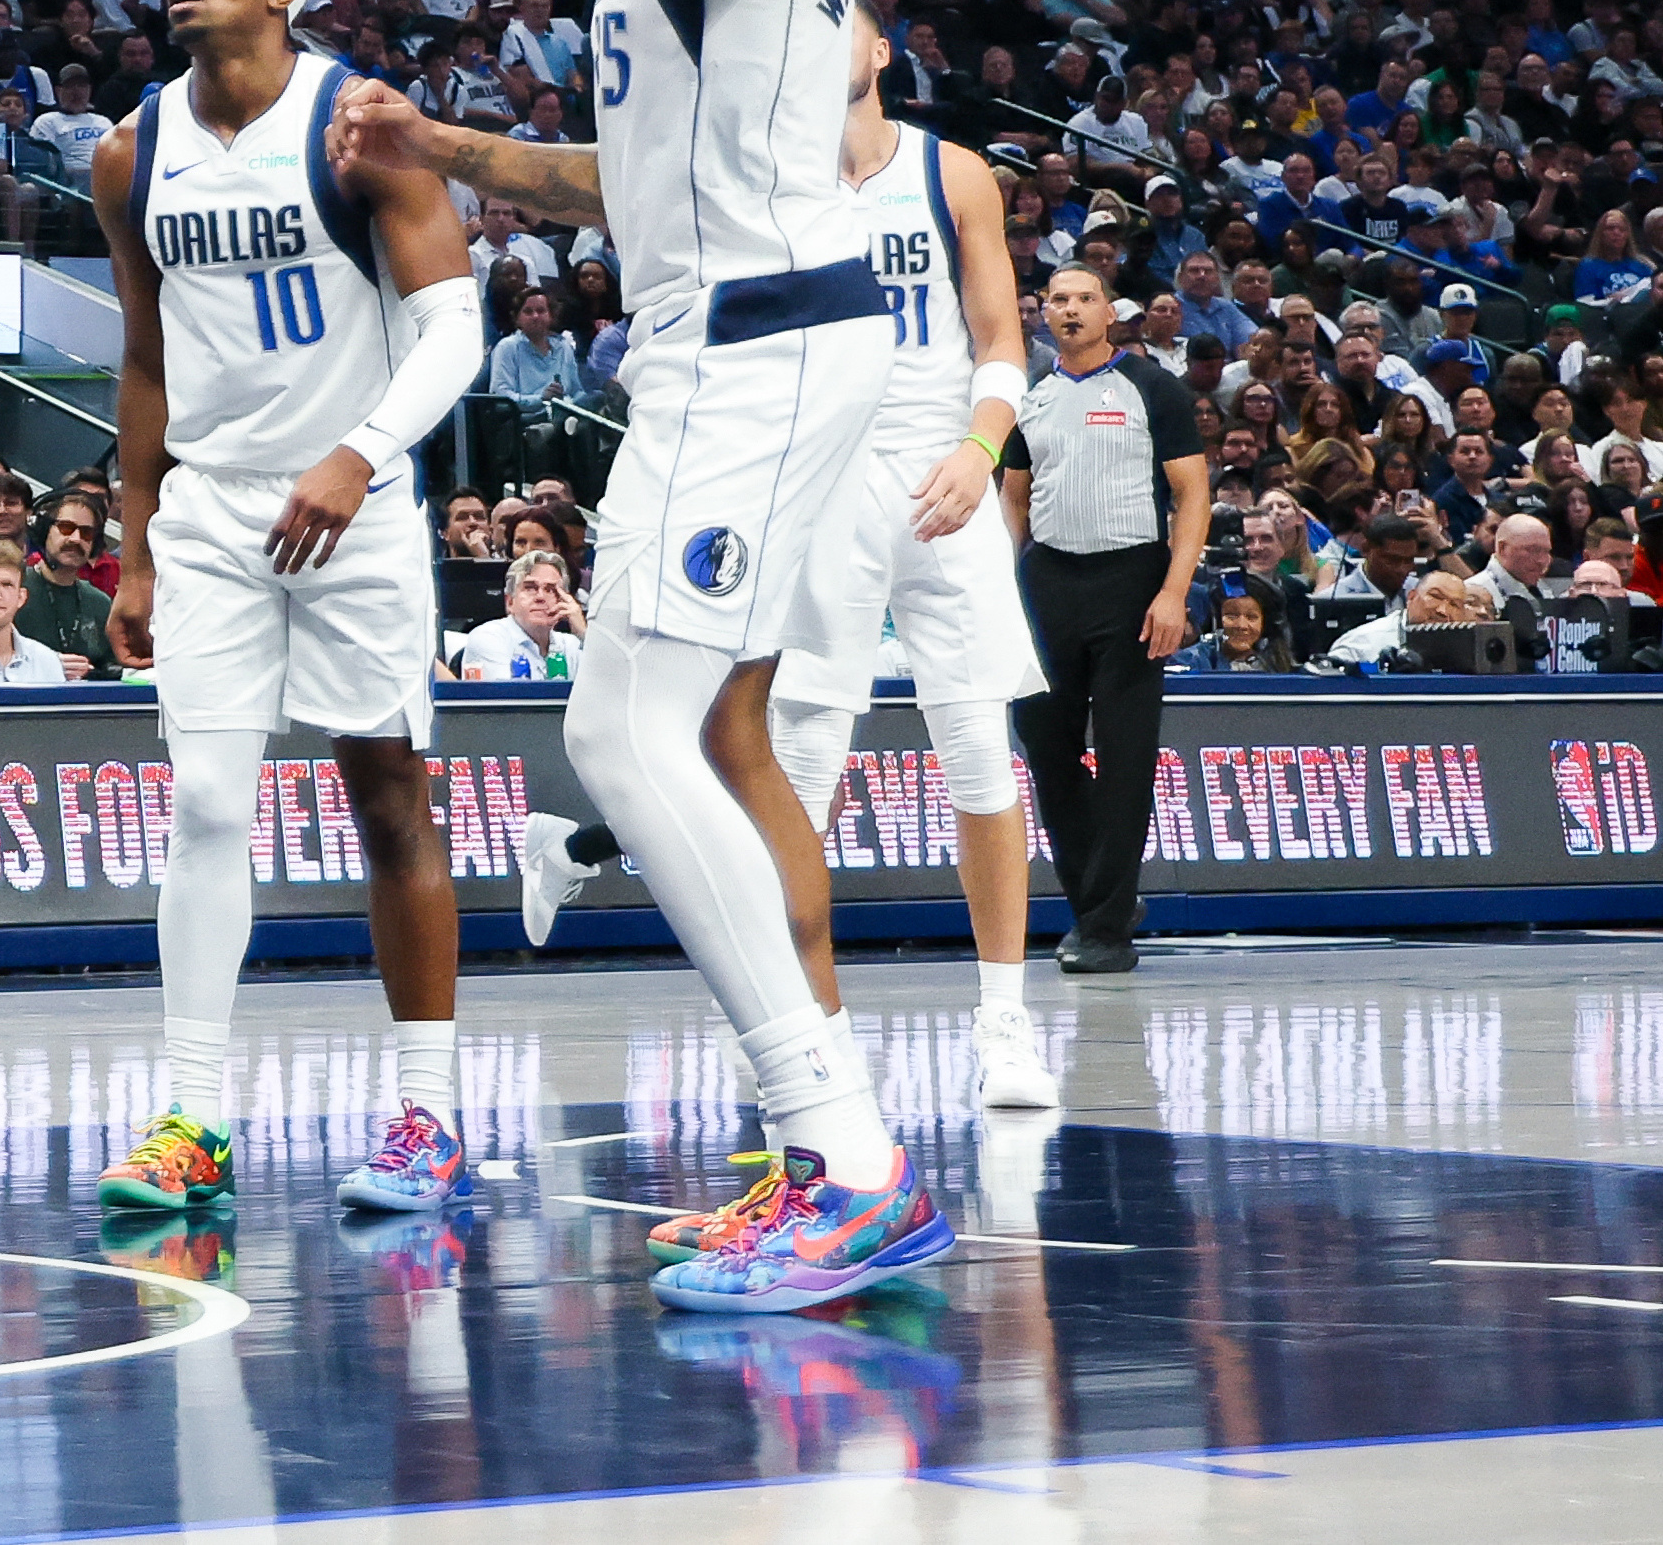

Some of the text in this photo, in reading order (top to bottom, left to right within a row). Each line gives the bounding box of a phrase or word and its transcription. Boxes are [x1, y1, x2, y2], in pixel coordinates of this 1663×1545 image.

[596, 11, 631, 108] 5
[247, 151, 300, 171] chime
[879, 192, 923, 207] chime
[155, 203, 309, 268] DALLAS
[245, 264, 327, 352] 10
[55, 757, 174, 889] FOR
[1200, 745, 1373, 861] EVERY
[1380, 743, 1493, 858] FAN
